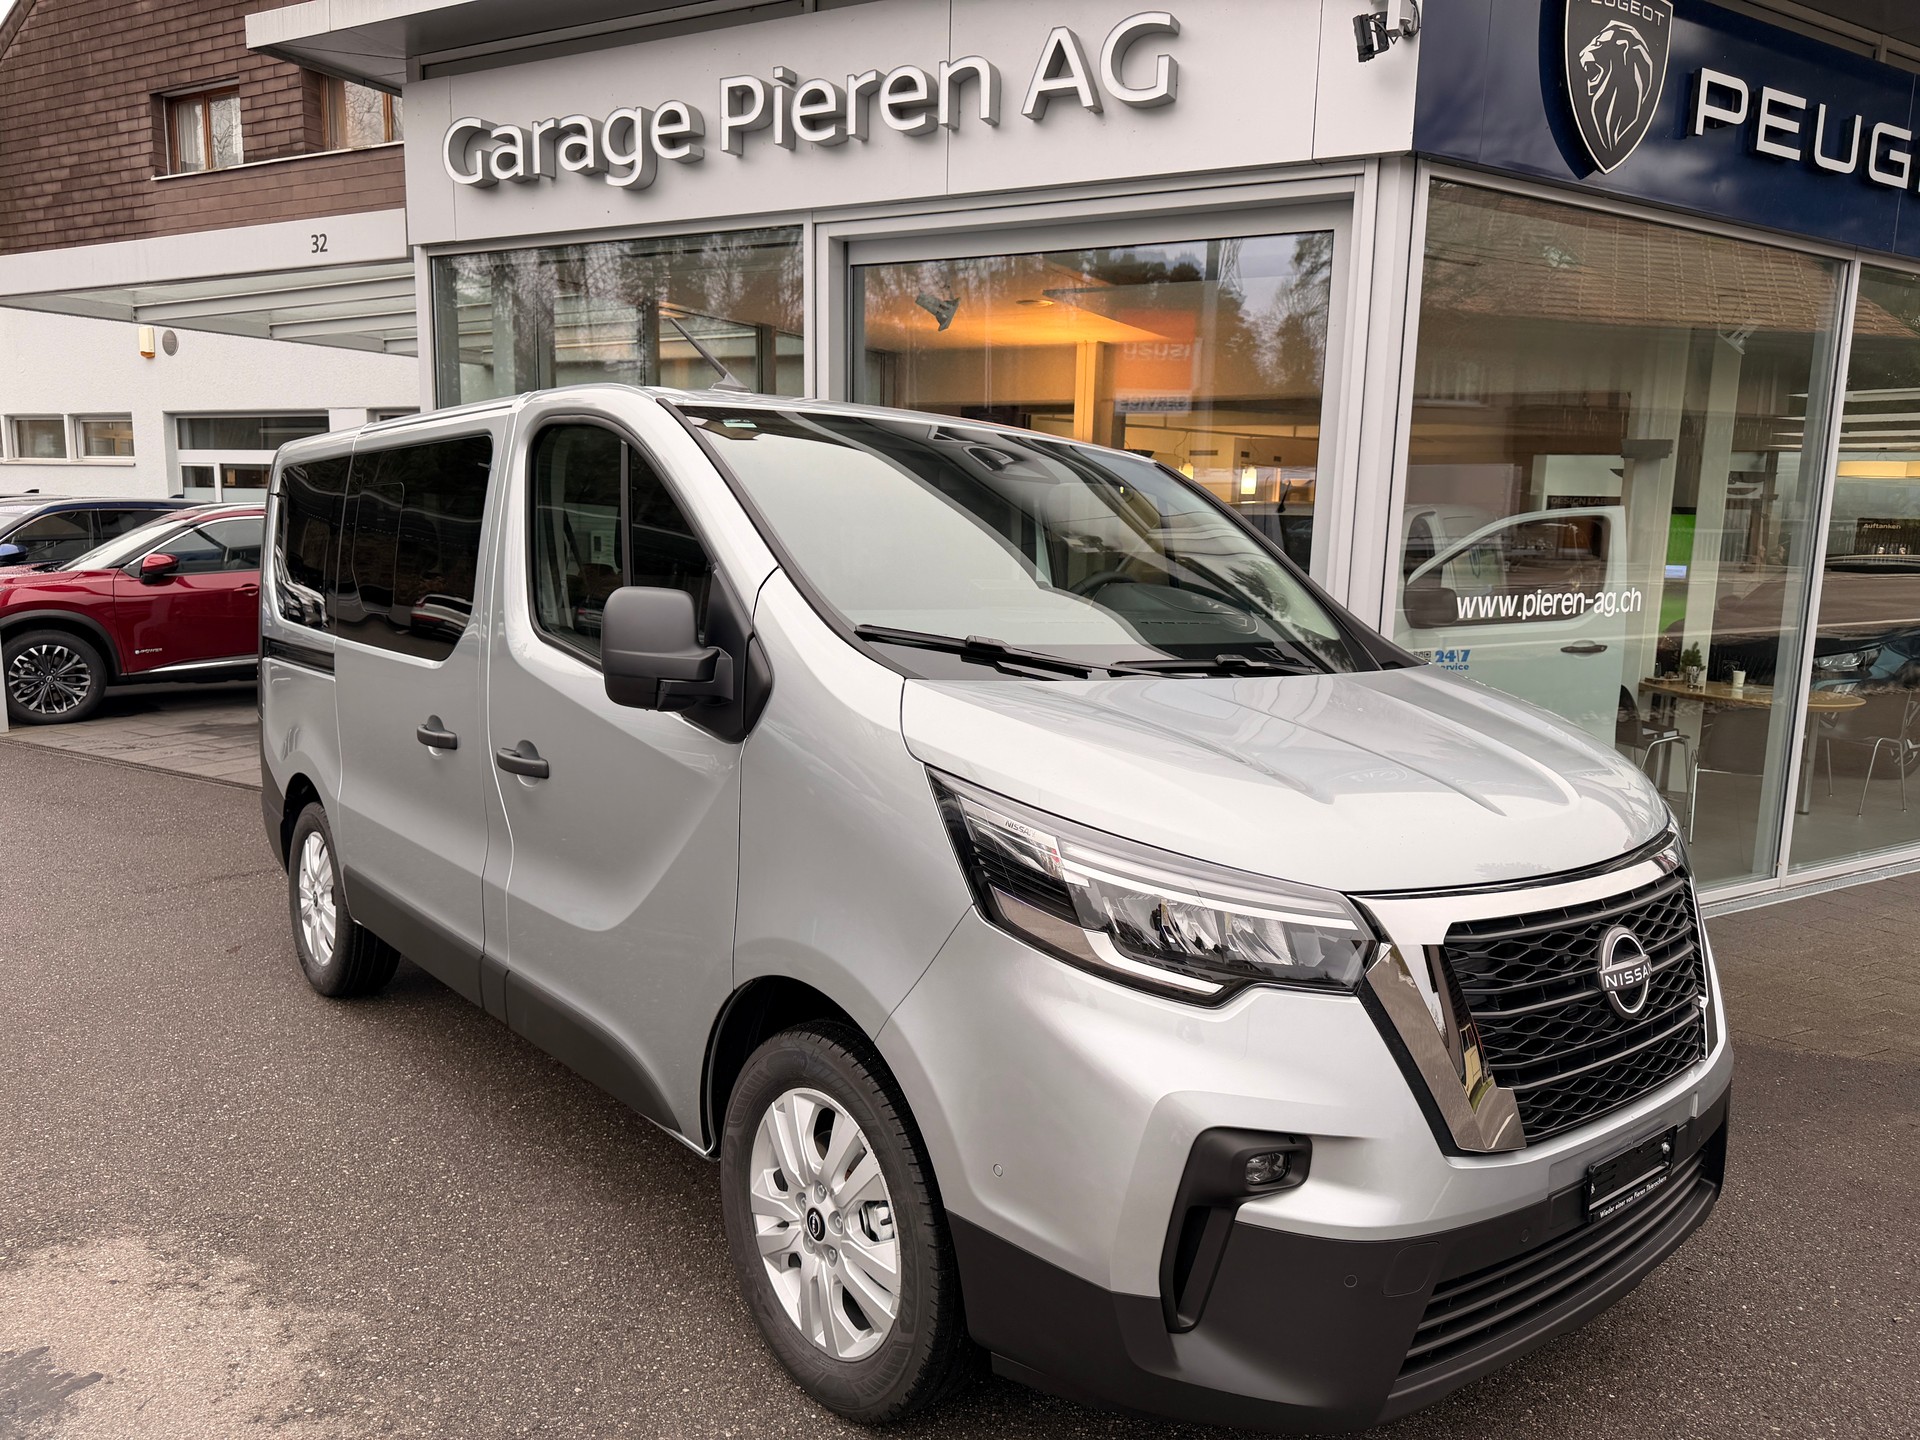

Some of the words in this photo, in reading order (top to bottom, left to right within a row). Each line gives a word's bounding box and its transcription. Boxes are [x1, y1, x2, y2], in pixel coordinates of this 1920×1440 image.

[442, 99, 706, 191] Garage
[719, 54, 1001, 156] Pieren
[1021, 11, 1180, 121] AG
[1694, 67, 1920, 193] PEUG
[311, 233, 328, 253] 32
[1456, 587, 1642, 620] www.pieren-ag.ch
[1604, 961, 1653, 988] NISSAN
